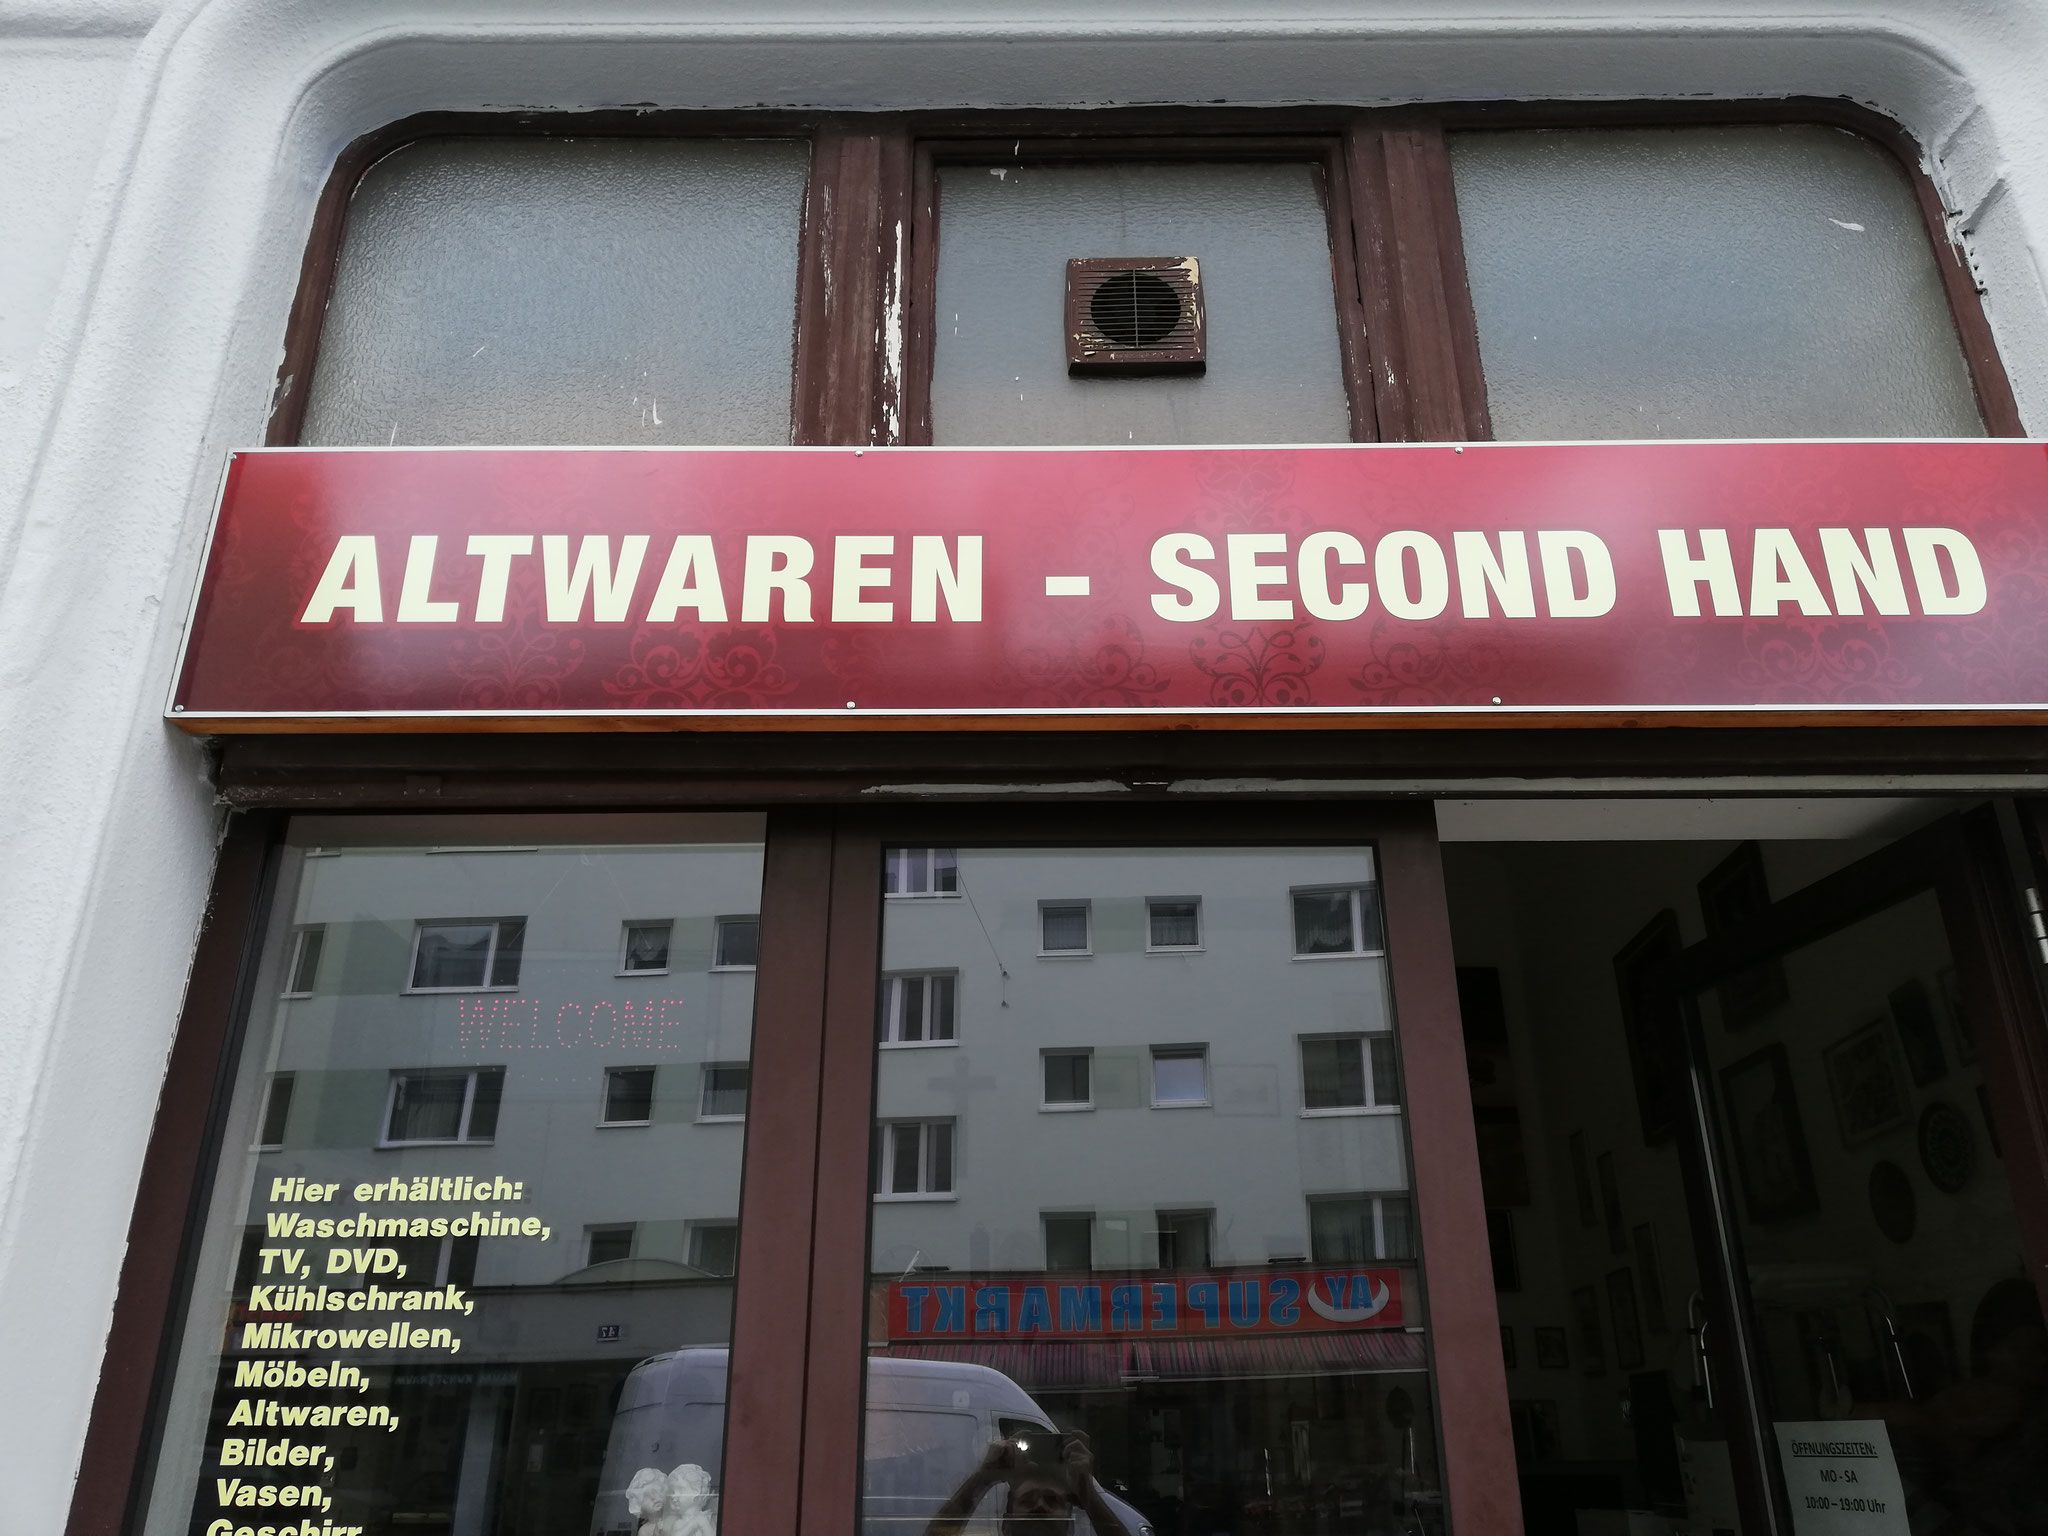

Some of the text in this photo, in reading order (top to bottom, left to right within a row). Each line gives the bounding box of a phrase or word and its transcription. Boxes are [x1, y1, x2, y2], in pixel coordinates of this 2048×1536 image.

[300, 526, 1989, 623] ALTWAREN - SECOND HAND
[459, 998, 684, 1049] WELCOME
[270, 1175, 524, 1202] Hier erhältlich:
[266, 1211, 551, 1242] Waschmaschine,
[258, 1247, 407, 1278] TV, DVD,
[248, 1284, 475, 1315] Kühlschrank,
[241, 1321, 462, 1353] Mikrowellen,
[234, 1359, 370, 1394] Möbeln,
[228, 1398, 400, 1432] Altwaren,
[219, 1438, 335, 1472] Bilder,
[1791, 1440, 1878, 1455] ÖFFNUNGSZEITEN:
[1820, 1469, 1837, 1483] MO
[1844, 1469, 1858, 1484] SA
[216, 1478, 332, 1513] Vasen,
[1805, 1496, 1830, 1510] 10:00
[1840, 1497, 1866, 1512] 19:00
[1867, 1499, 1886, 1514] Uhr
